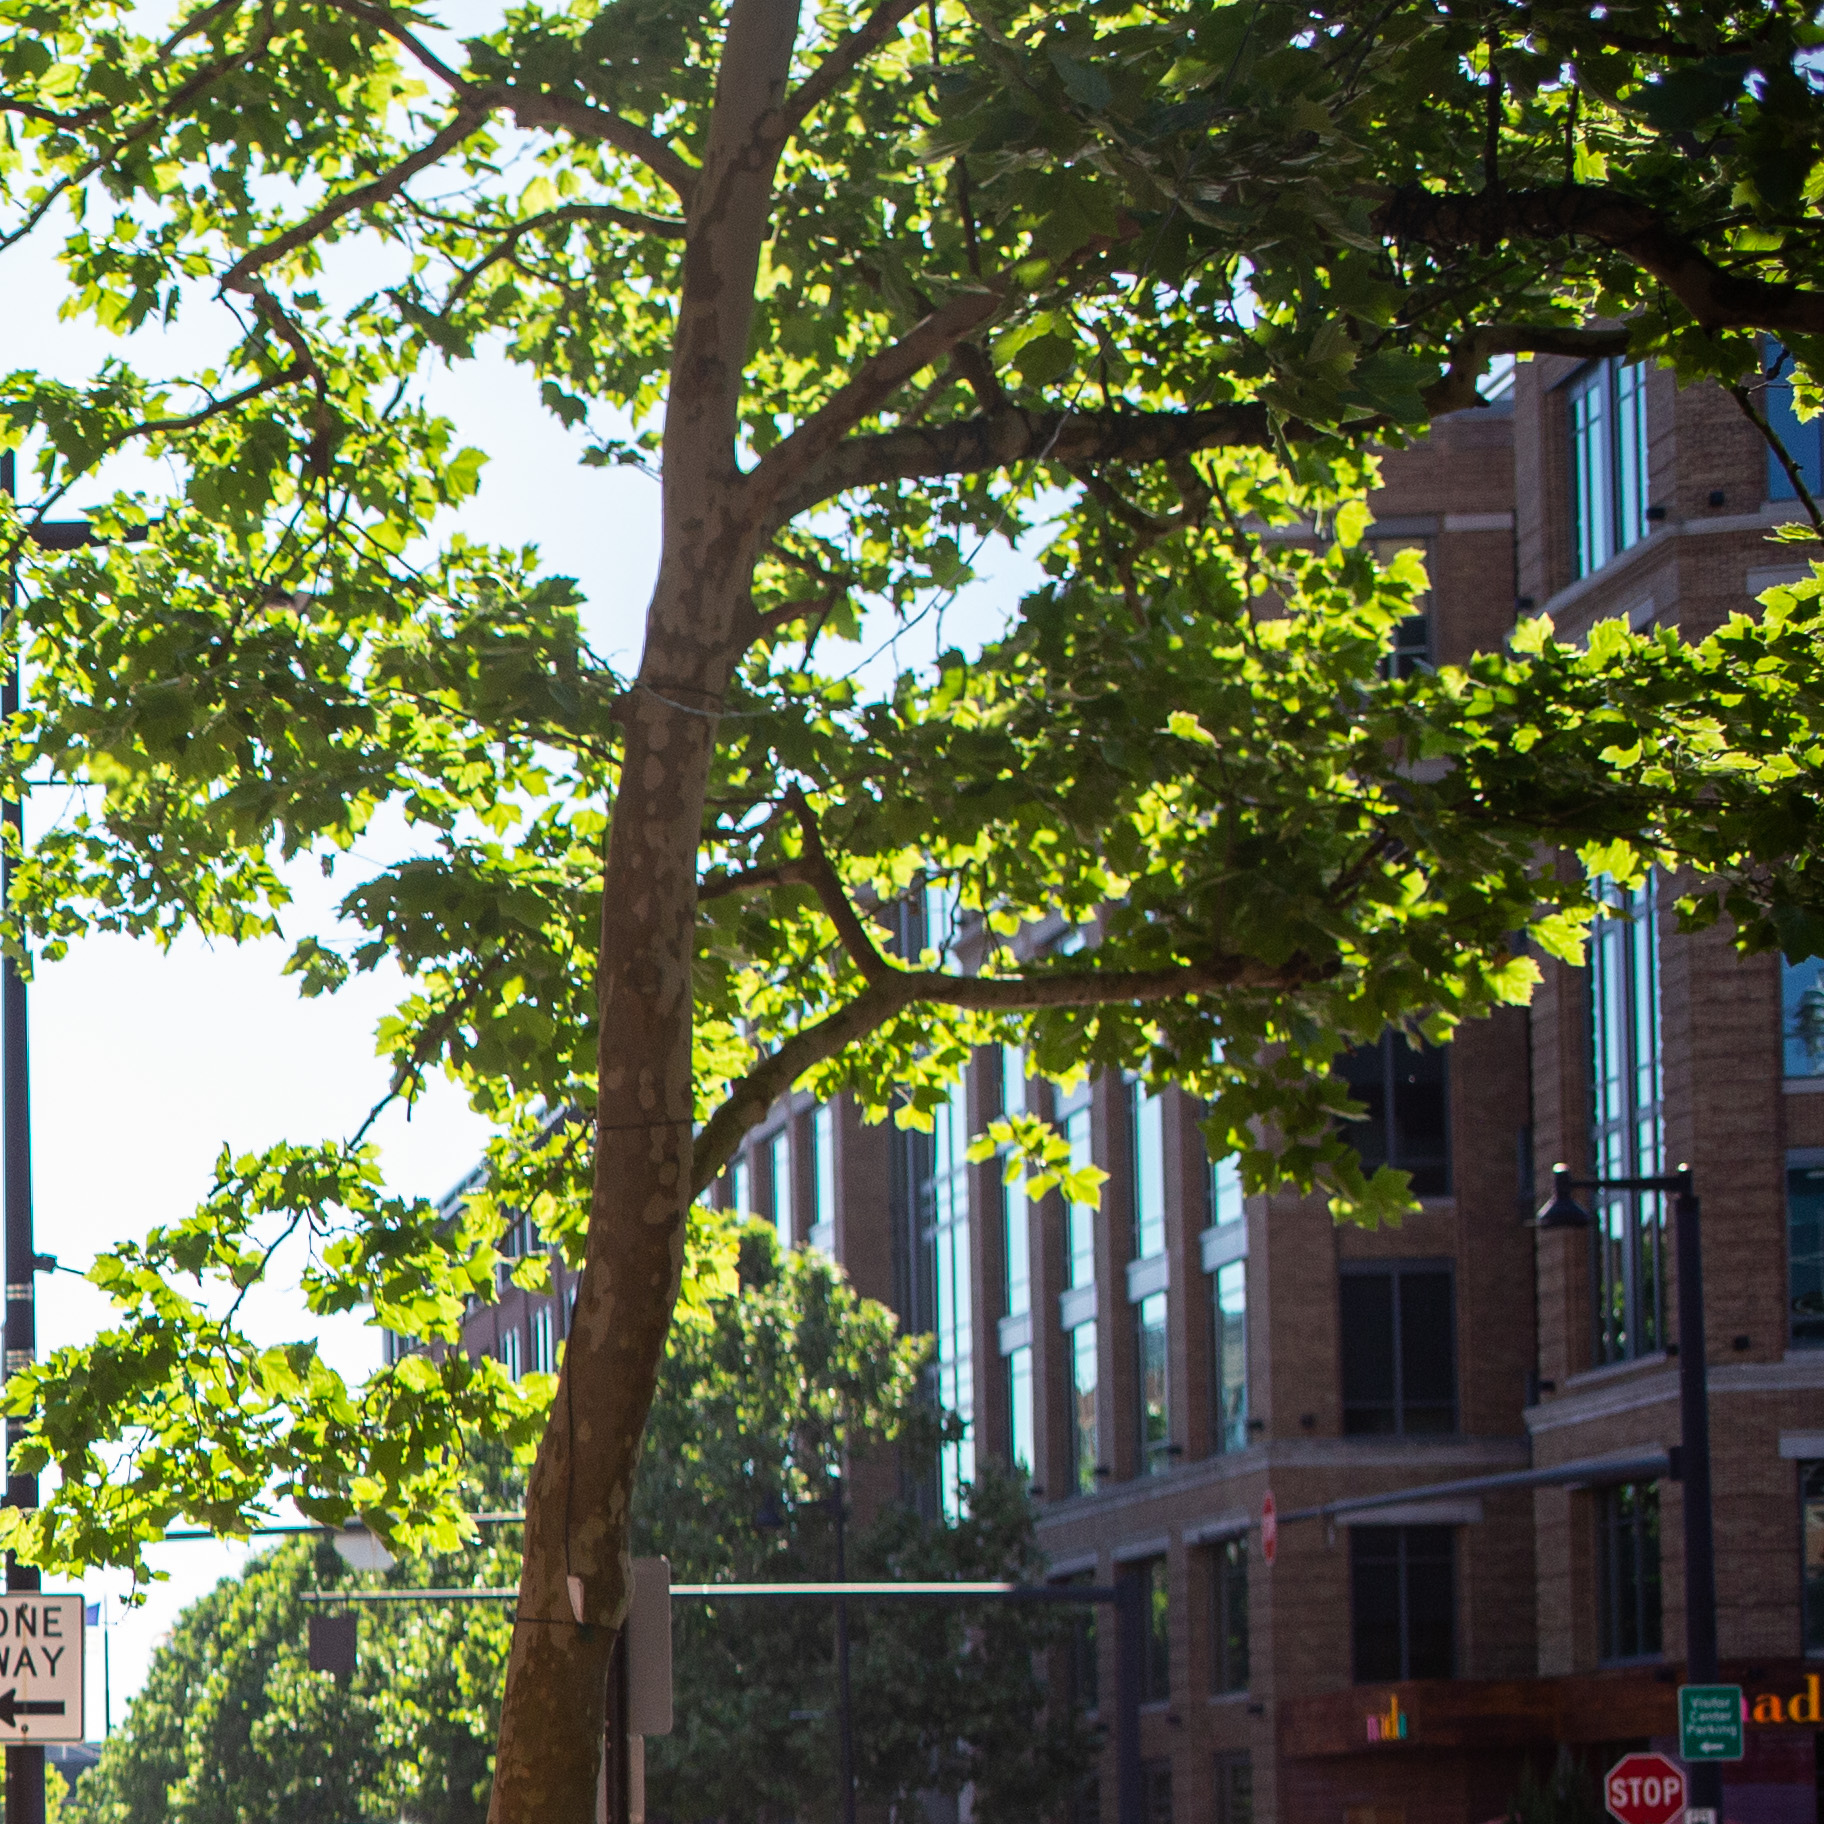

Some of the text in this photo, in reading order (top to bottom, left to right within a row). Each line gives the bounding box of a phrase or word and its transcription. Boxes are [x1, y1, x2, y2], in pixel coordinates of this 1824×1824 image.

[1690, 1697, 1731, 1708] Visitor
[1689, 1711, 1733, 1722] Center
[1686, 1724, 1738, 1737] Parking
[1610, 1776, 1681, 1808] STOP
